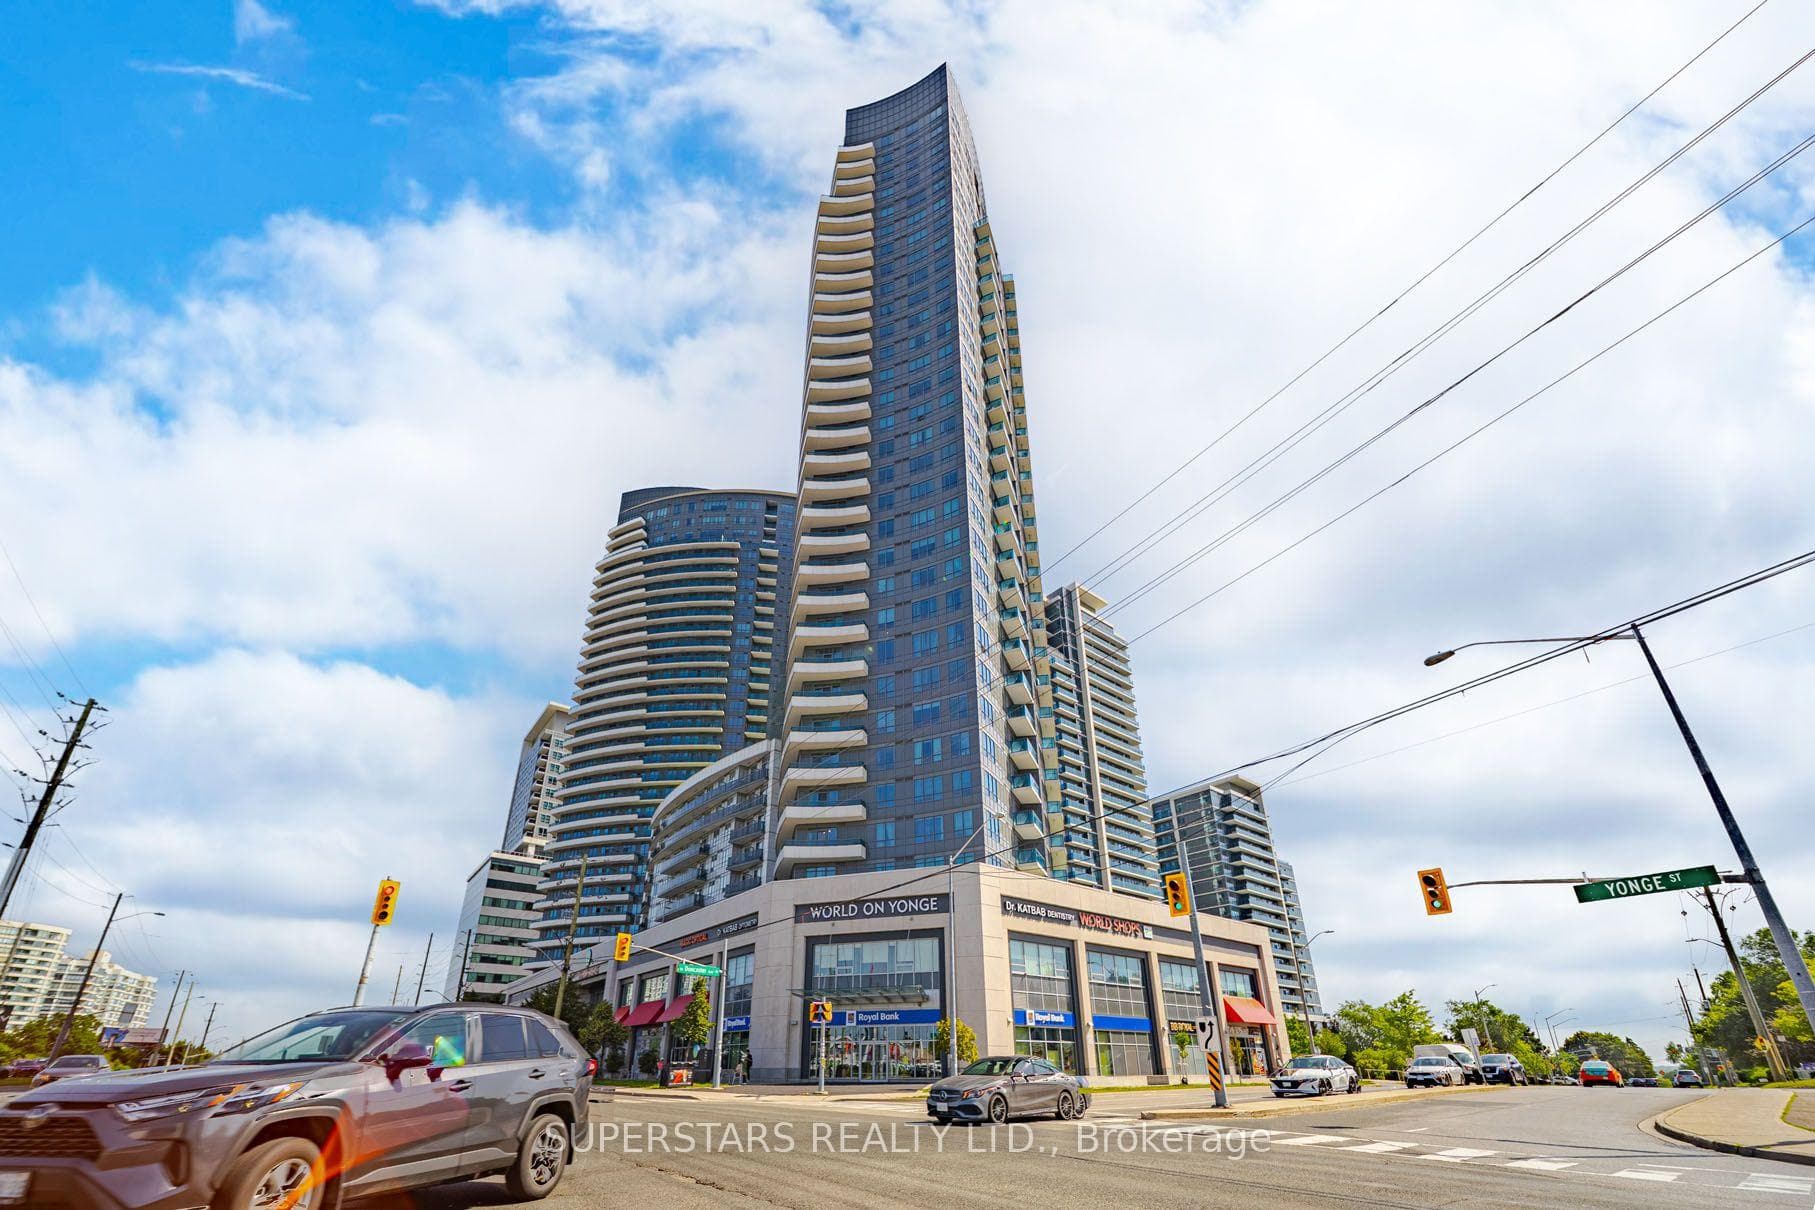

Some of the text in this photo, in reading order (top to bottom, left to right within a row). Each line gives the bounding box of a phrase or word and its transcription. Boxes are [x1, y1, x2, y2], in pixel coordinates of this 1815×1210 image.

[1604, 872, 1682, 897] YONGE ST
[810, 897, 938, 919] WORLD ON YONGE
[1005, 901, 1075, 921] Dr. KATBAB DENTISTRY
[1079, 912, 1142, 936] WORLD SHOPS
[858, 1011, 899, 1022] Royal Bank
